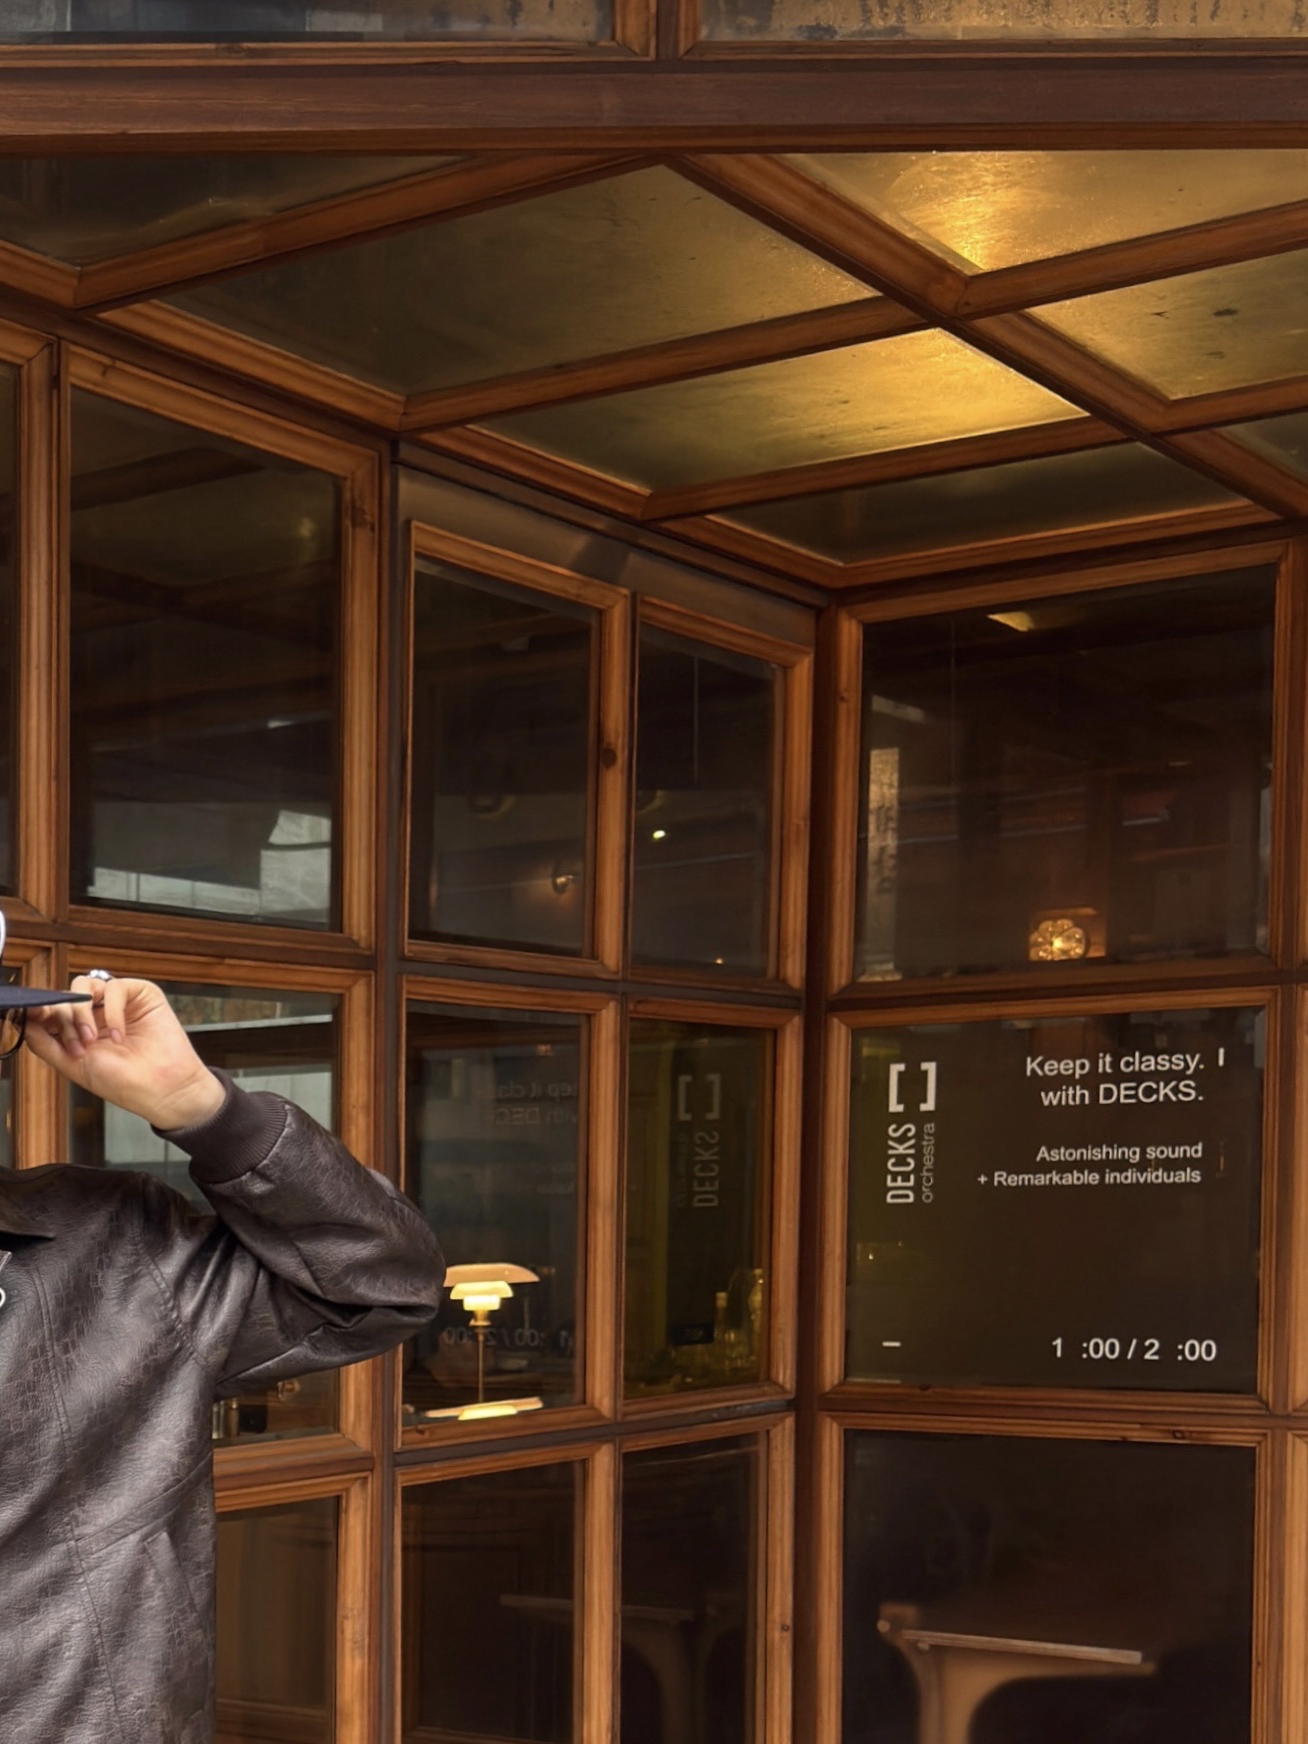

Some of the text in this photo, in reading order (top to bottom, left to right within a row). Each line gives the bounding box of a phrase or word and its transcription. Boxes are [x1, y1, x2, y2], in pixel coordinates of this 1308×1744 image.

[1025, 1049, 1205, 1079] Keep it classy.
[1040, 1079, 1204, 1107] with DECKS.
[886, 1122, 916, 1204] DECKS
[921, 1122, 936, 1204] orchestra
[1036, 1141, 1203, 1164] Astonishing sound
[993, 1168, 1100, 1187] Remarkable
[1104, 1166, 1202, 1185] individuals
